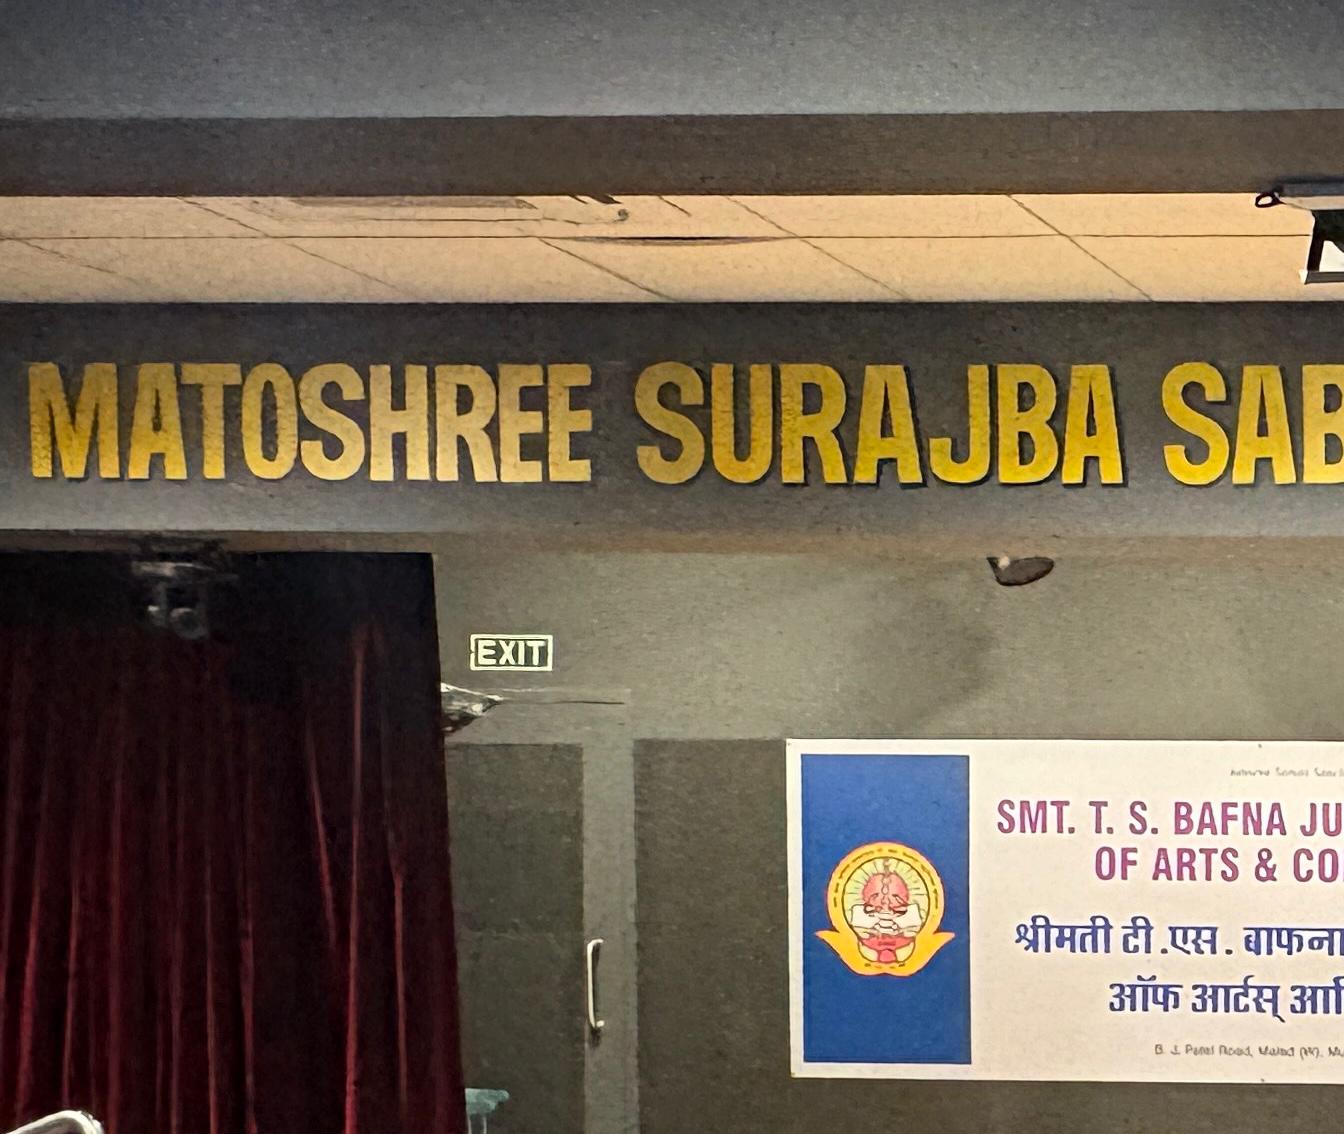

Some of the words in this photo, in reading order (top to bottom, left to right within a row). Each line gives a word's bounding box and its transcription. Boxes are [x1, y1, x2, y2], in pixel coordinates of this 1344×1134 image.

[28, 362, 592, 483] MATOSHREE
[635, 361, 1125, 486] SURAJBA
[477, 639, 545, 667] EXIT
[997, 800, 1076, 836] SMT.
[1088, 800, 1114, 836] T.
[1129, 801, 1159, 836] S.
[1173, 801, 1287, 837] BAFNA
[1094, 845, 1139, 881] OF
[1151, 846, 1240, 883] ARTS
[1254, 847, 1278, 883] &
[1014, 914, 1114, 954] श्रीमती
[1108, 974, 1184, 1013] ऑफ
